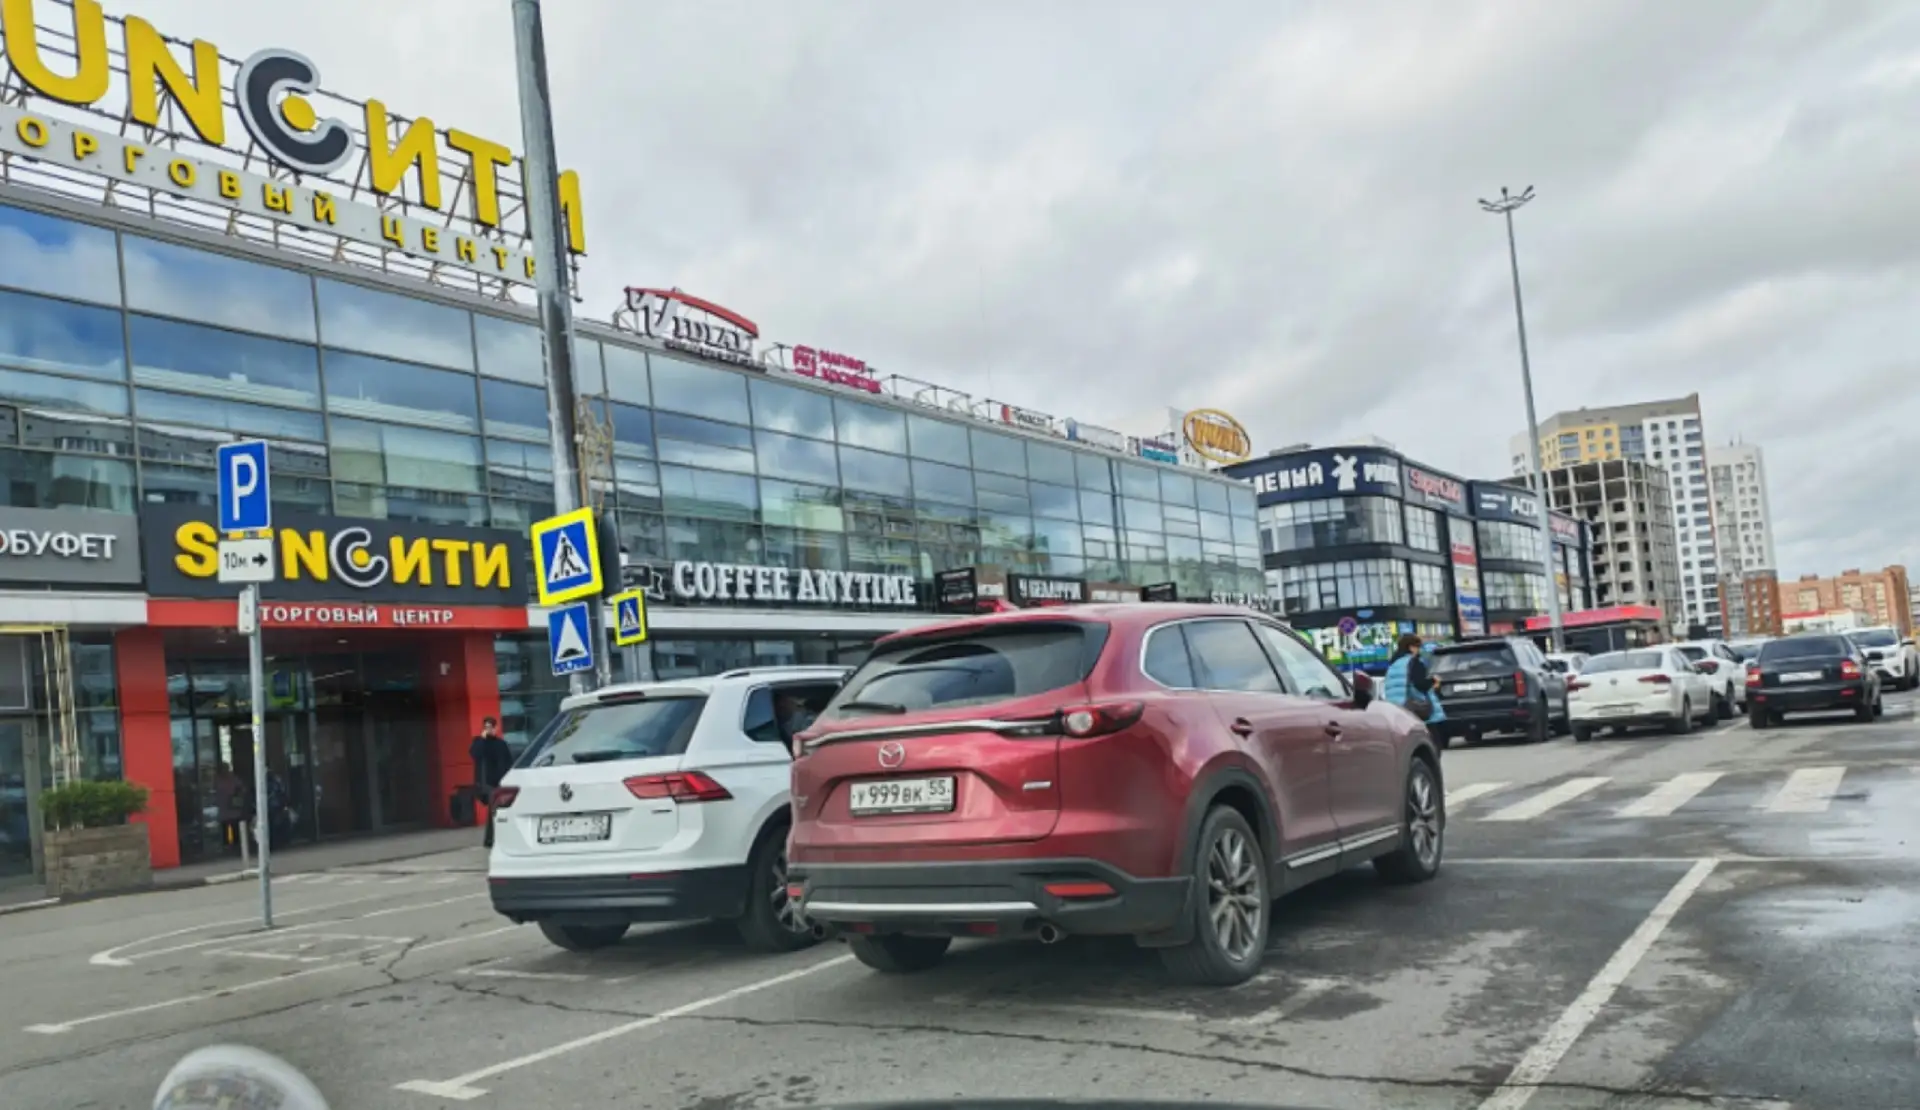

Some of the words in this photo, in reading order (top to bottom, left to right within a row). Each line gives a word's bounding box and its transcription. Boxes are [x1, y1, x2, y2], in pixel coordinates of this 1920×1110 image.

[673, 561, 790, 600] COFFEE
[797, 568, 917, 604] ANYTIME
[260, 605, 378, 624] ТОРГОВЫЙ
[393, 608, 454, 625] ЦЕНТР
